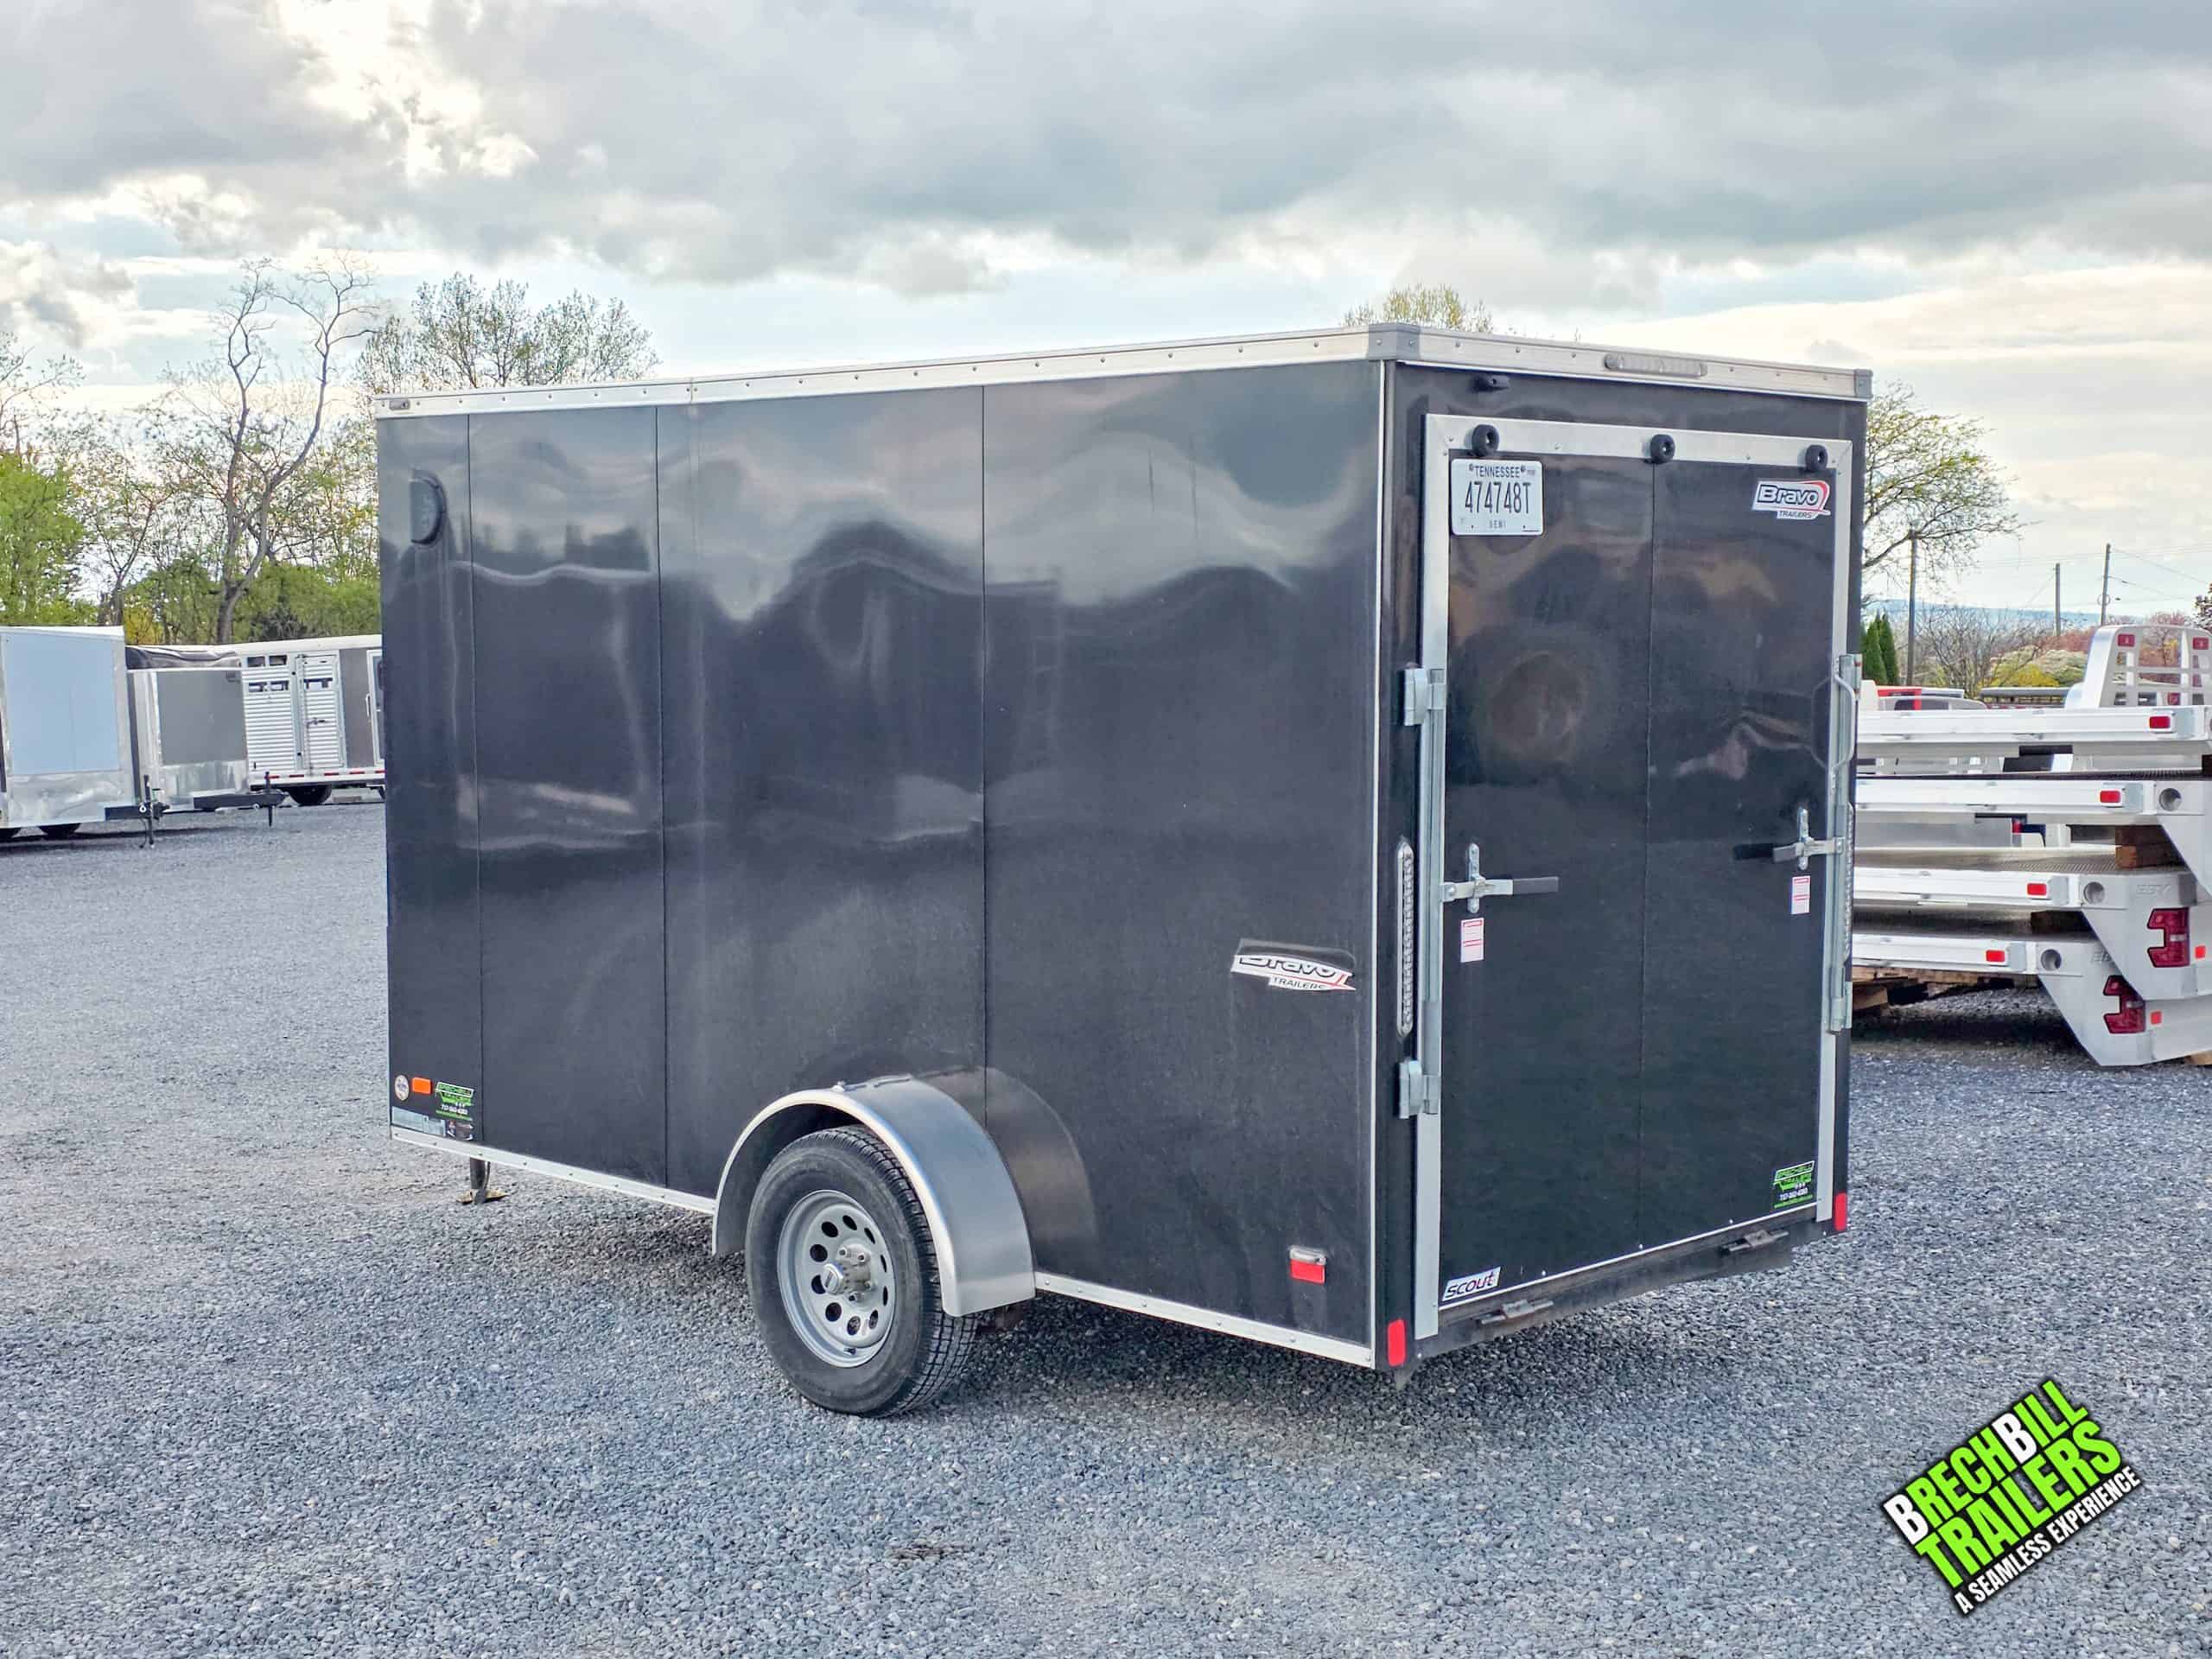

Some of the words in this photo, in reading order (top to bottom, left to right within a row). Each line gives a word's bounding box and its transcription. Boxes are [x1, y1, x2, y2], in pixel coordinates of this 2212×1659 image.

[1474, 465, 1520, 478] TENNESSEE
[1465, 480, 1531, 514] 474748T
[1757, 484, 1819, 505] Bravo
